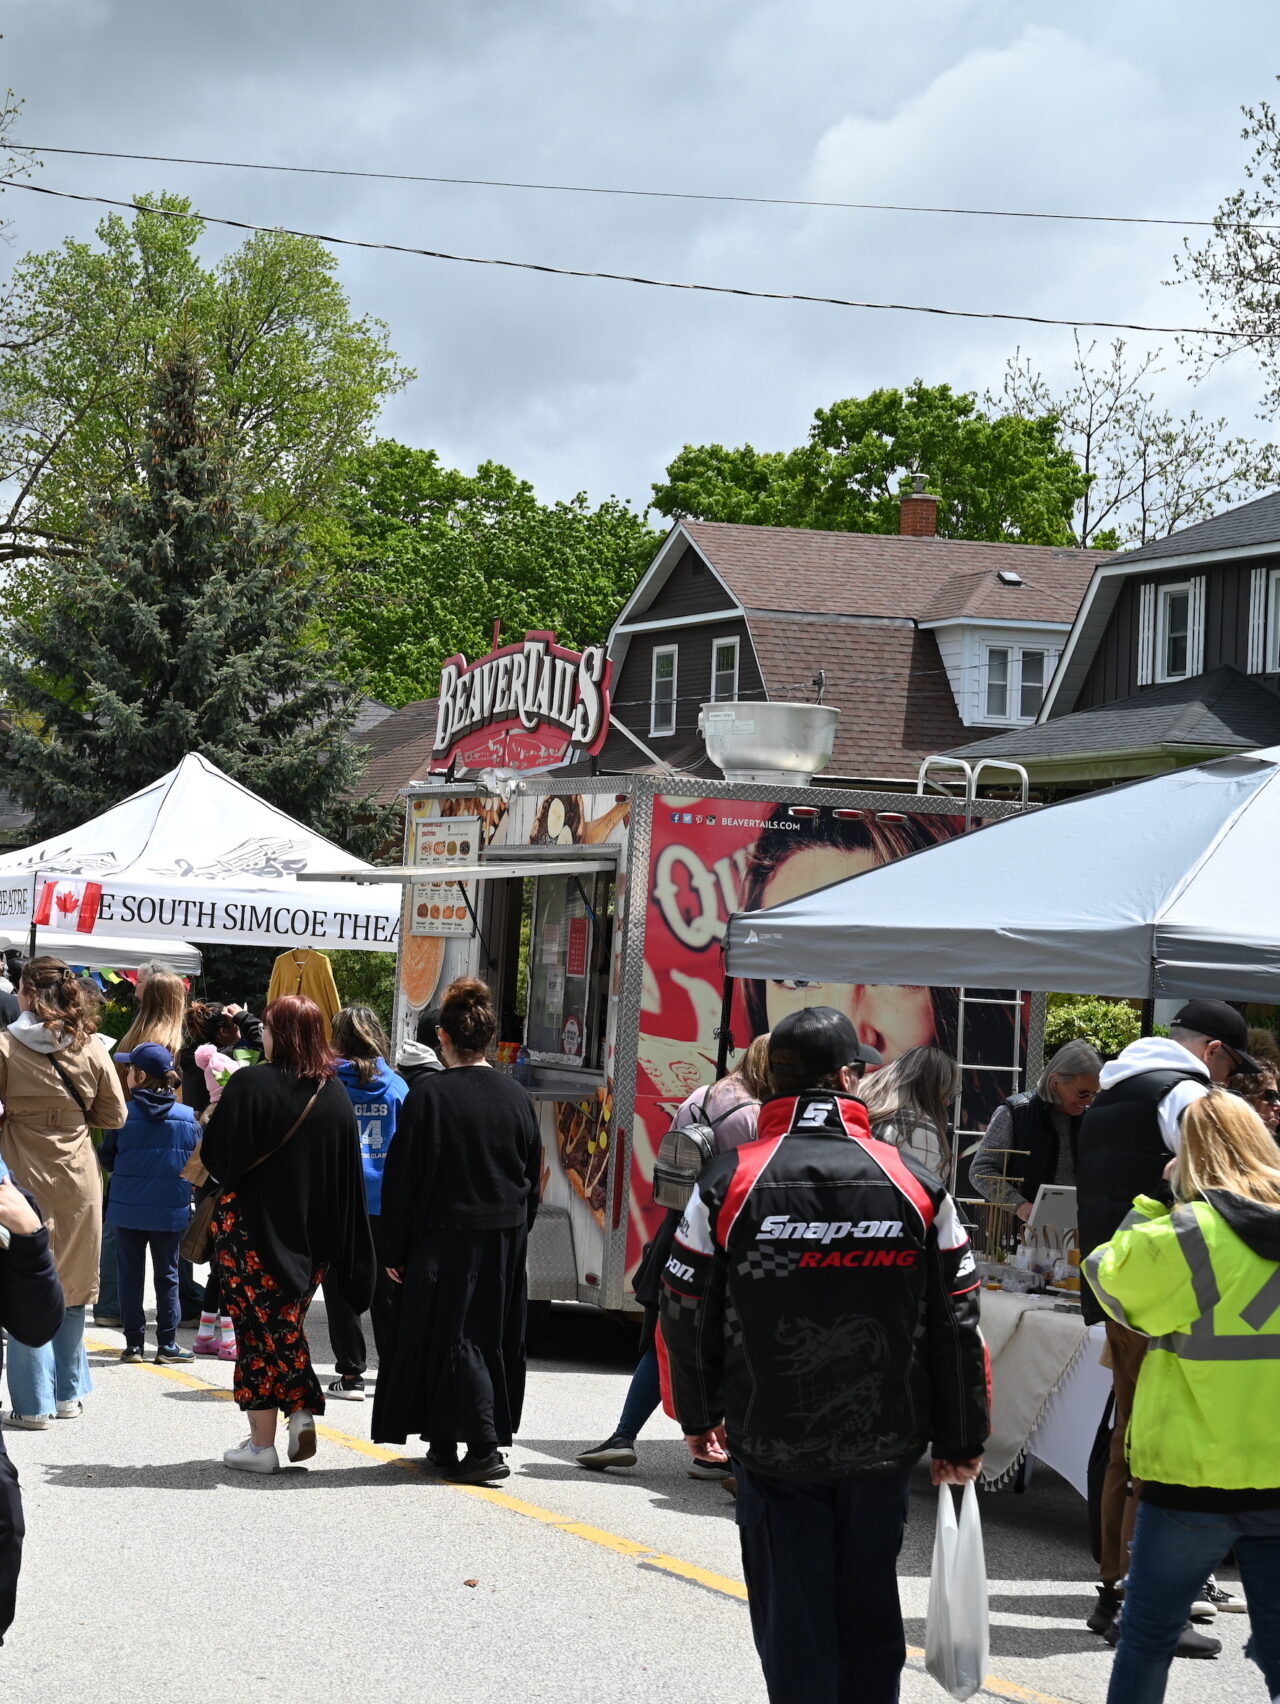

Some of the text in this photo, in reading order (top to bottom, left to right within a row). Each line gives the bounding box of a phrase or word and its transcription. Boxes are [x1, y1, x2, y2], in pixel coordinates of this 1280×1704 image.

[432, 641, 606, 751] BEAVERTAILS
[721, 817, 801, 831] BEAVERTAILS.COM
[121, 895, 217, 929] SOUTH
[222, 903, 328, 938] SIMCOE
[798, 1250, 918, 1268] RACING
